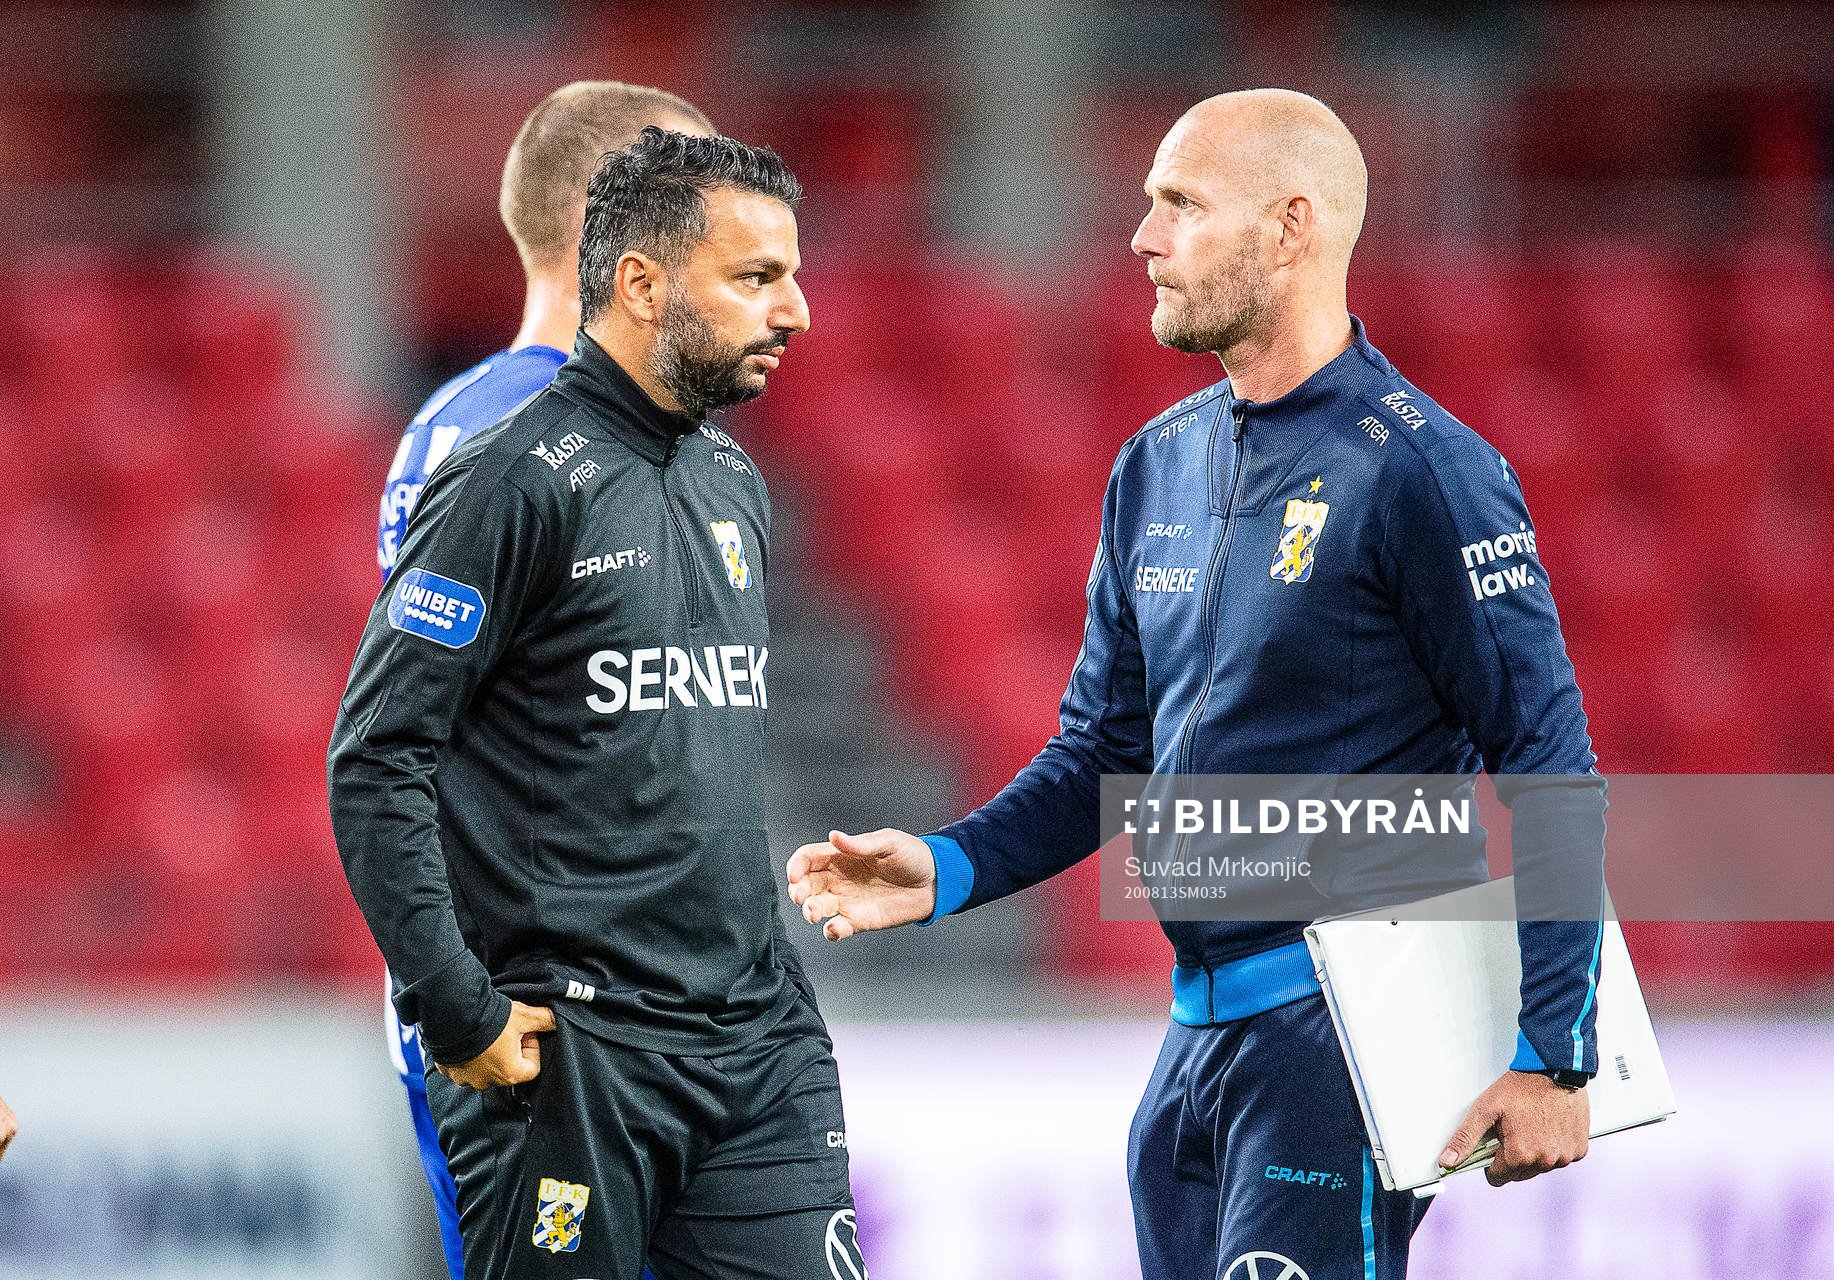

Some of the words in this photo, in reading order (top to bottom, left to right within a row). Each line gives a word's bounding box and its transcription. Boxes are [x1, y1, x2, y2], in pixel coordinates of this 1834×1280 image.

[1380, 391, 1428, 431] RASTA
[541, 431, 590, 471] RASTA
[1145, 523, 1185, 538] CRAFT
[1461, 521, 1537, 569] moris
[571, 549, 636, 580] CRAFT
[1136, 565, 1200, 593] SERNEKE
[1468, 563, 1535, 601] law.
[399, 582, 476, 622] UNIBET
[1264, 1165, 1332, 1186] CRAFT
